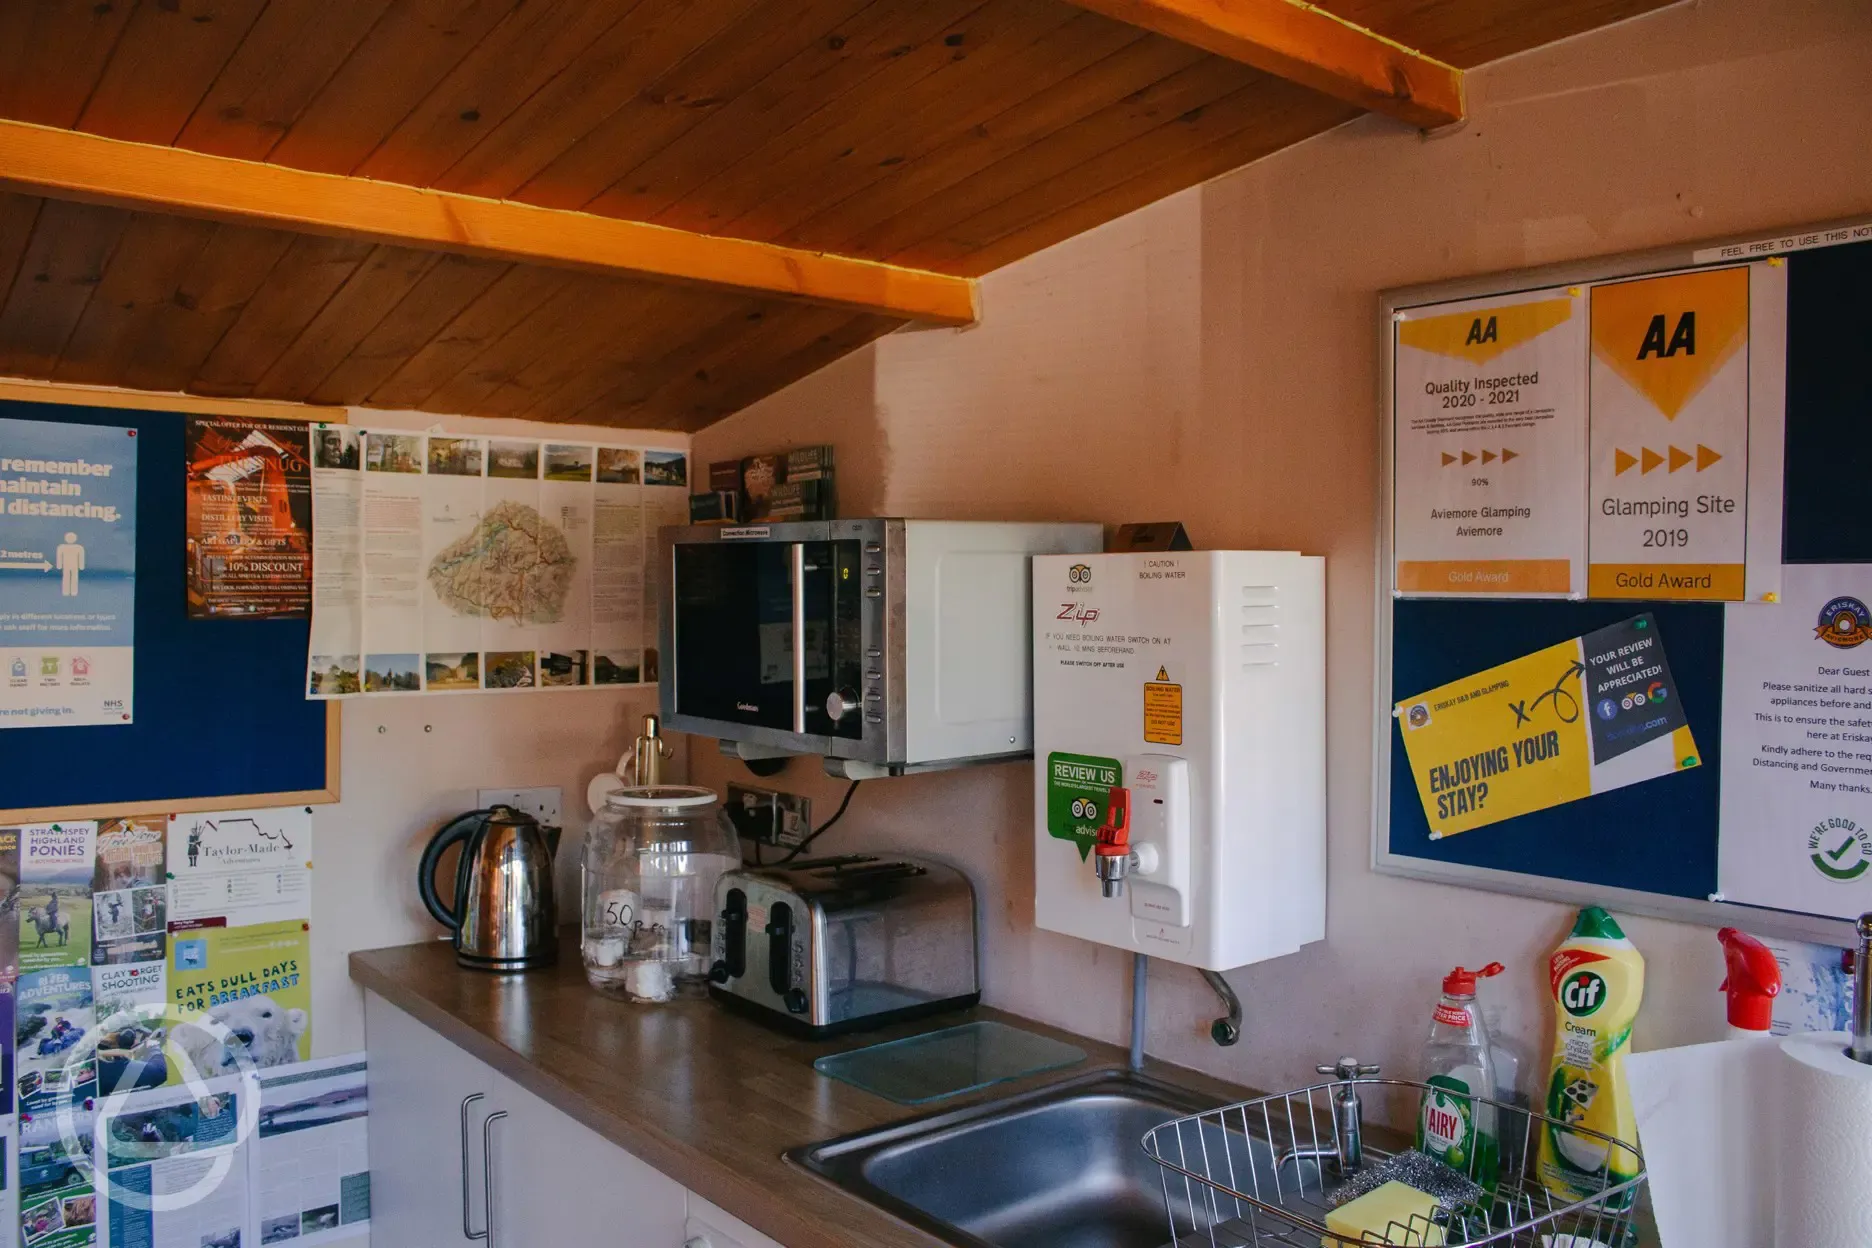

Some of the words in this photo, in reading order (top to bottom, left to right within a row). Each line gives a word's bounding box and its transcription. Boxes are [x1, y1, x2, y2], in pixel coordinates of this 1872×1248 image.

[1720, 247, 1744, 258] FEEL
[1749, 241, 1775, 253] FREE
[1779, 238, 1794, 249] TO
[1798, 234, 1820, 246] USE
[1824, 230, 1848, 242] THIS
[1465, 315, 1498, 346] AA
[1636, 311, 1696, 361] AA
[1425, 380, 1470, 395] Quality
[1474, 371, 1539, 391] Inspected
[1442, 393, 1476, 409] 2020
[1488, 389, 1520, 405] 2021
[1, 459, 113, 477] remember
[1471, 478, 1489, 487] 90%
[238, 495, 268, 503] EVENTS
[8, 499, 122, 522] distancing.
[1430, 508, 1478, 519] Aviemore
[1481, 506, 1531, 518] Glamping
[1602, 496, 1689, 518] Glamping
[1696, 495, 1736, 514] Site
[201, 513, 247, 522] DISTILLERY
[249, 514, 273, 523] VISITS
[1456, 526, 1503, 536] Aviemore
[1642, 529, 1689, 547] 2019
[264, 538, 286, 546] GIFTS
[8, 551, 43, 560] metres
[228, 561, 248, 572] 10%
[250, 562, 304, 572] DISCOUNT
[1149, 560, 1175, 568] CAUTION
[1139, 571, 1162, 579] BOILING
[1448, 570, 1474, 582] Gold
[1475, 570, 1509, 583] Award
[1615, 572, 1653, 588] Gold
[1658, 572, 1712, 589] Award
[1057, 602, 1100, 627] Zip
[1826, 601, 1865, 616] ERISKAY
[1098, 646, 1135, 654] BEFOREHAND
[1589, 650, 1617, 666] YOUR
[1618, 637, 1653, 657] REVIEW
[1606, 662, 1631, 675] WILL
[1632, 656, 1645, 667] BE
[1818, 666, 1840, 676] Dear
[1842, 667, 1870, 677] Guest
[1598, 664, 1663, 693] APPRECIATED!
[1763, 681, 1791, 691] Please
[1794, 683, 1828, 693] sanitize
[1830, 684, 1841, 694] all
[1844, 684, 1866, 695] hard
[1434, 697, 1456, 711] ERISKAY
[1469, 689, 1481, 699] AND
[1481, 680, 1510, 695] GLAMPING
[1770, 697, 1818, 707] appliances
[1820, 698, 1851, 709] before
[1853, 700, 1872, 710] and
[1754, 712, 1772, 722] This
[1774, 713, 1781, 722] is
[1783, 715, 1794, 724] to
[1796, 716, 1827, 726] ensure
[1829, 716, 1845, 726] the
[1806, 730, 1828, 739] here
[1761, 744, 1788, 756] Kindly
[1790, 747, 1822, 757] adhere
[1825, 749, 1835, 758] to
[1837, 750, 1853, 760] the
[1429, 746, 1509, 794] ENJOYING
[1512, 730, 1560, 768] YOUR
[1752, 758, 1799, 771] Distancing
[1801, 762, 1818, 771] and
[1054, 764, 1096, 781] REVIEW
[1100, 769, 1116, 784] US
[1810, 780, 1836, 792] Many
[1838, 783, 1872, 794] thanks.
[1437, 782, 1489, 820] STAY?
[1828, 817, 1856, 831] GOOD
[30, 836, 86, 845] HIGHLAND
[1808, 821, 1828, 849] WE'RE
[1855, 827, 1868, 841] TO
[30, 845, 85, 857] PONIES
[203, 843, 280, 857] Taylor-Made
[1861, 842, 1872, 855] GO
[220, 857, 261, 865] Adventures
[101, 972, 126, 981] CLAY
[102, 973, 160, 991] SHOOTING
[176, 981, 215, 999] EATS
[220, 971, 257, 989] DULL
[262, 960, 298, 978] DAYS
[20, 981, 92, 1001] ADVENTURES
[177, 998, 205, 1014] FOR
[209, 973, 300, 1007] BREAKFAST
[1564, 975, 1600, 1008] Cif
[1565, 1022, 1596, 1037] Cream
[1565, 1043, 1592, 1056] Crystals
[1569, 1039, 1589, 1048] micro
